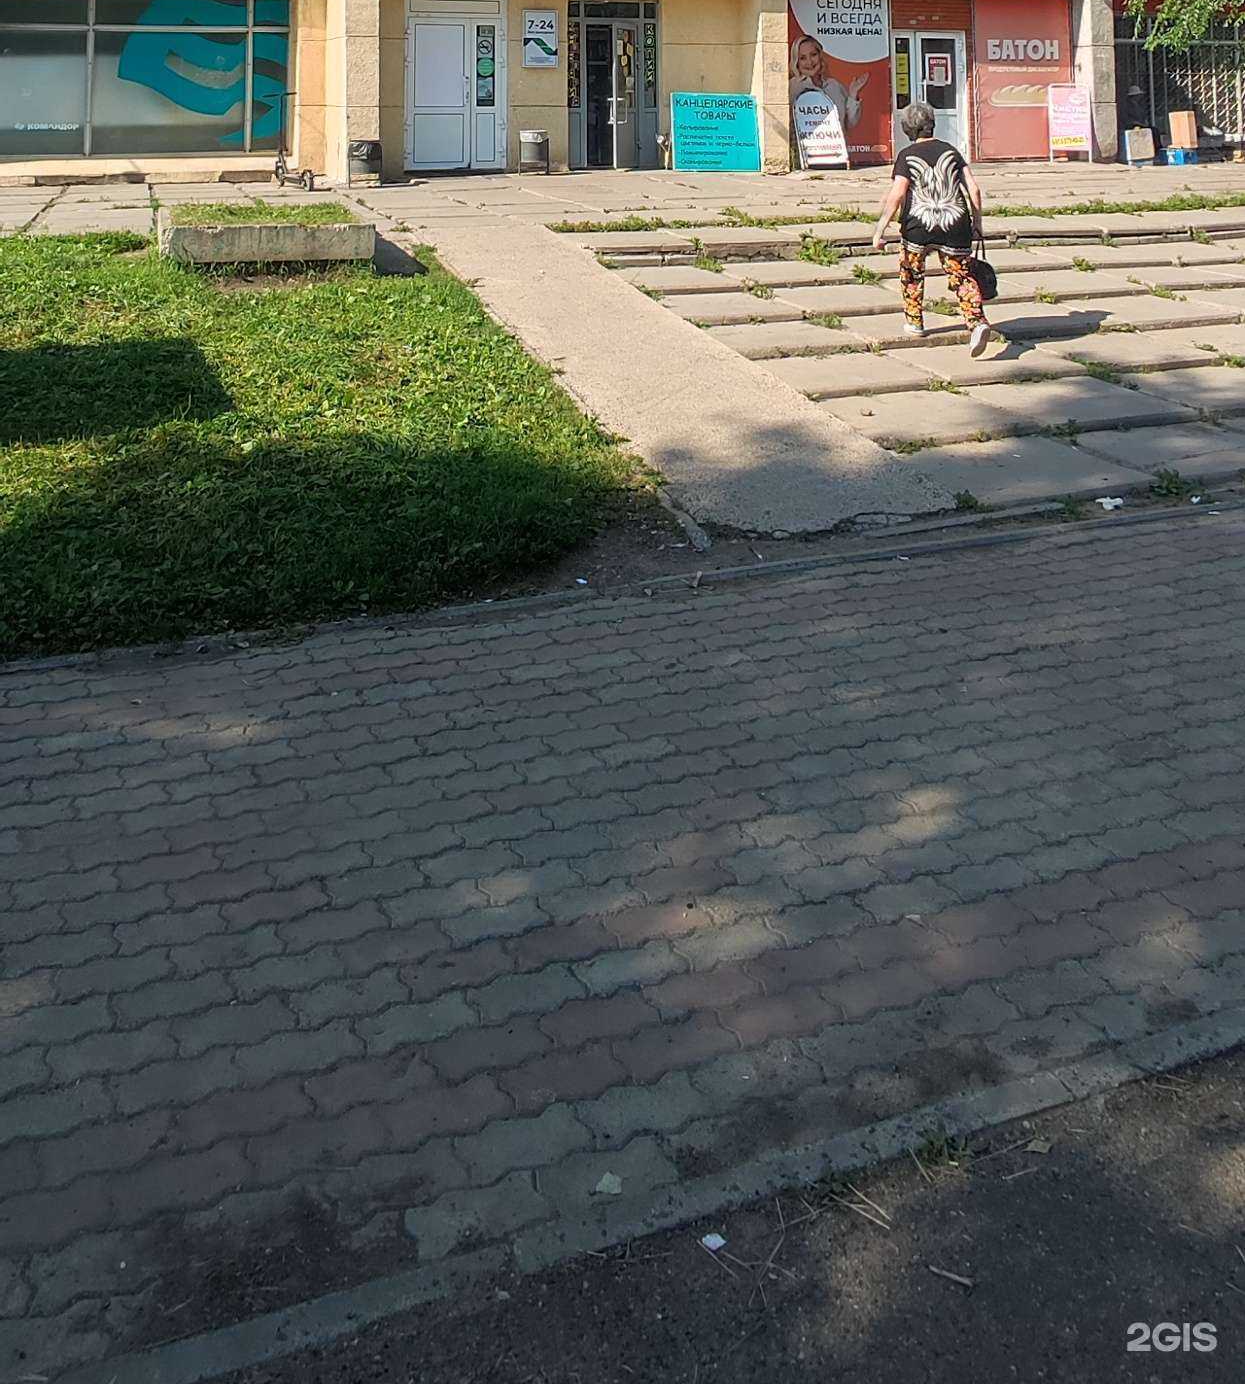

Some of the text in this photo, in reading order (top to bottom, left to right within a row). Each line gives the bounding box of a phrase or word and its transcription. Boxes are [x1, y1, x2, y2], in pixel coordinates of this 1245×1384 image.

[527, 19, 554, 30] 7-24
[817, 13, 883, 26] И ВСЕГДА
[816, 27, 883, 36] НИЗКАЯ ЦЕНА!
[987, 39, 1059, 61] БАТОН
[675, 98, 754, 110] КАНЦЕЛЯРСКИЕ
[694, 111, 737, 121] ТОВАРЫ
[798, 105, 830, 116] ЧАСЫ
